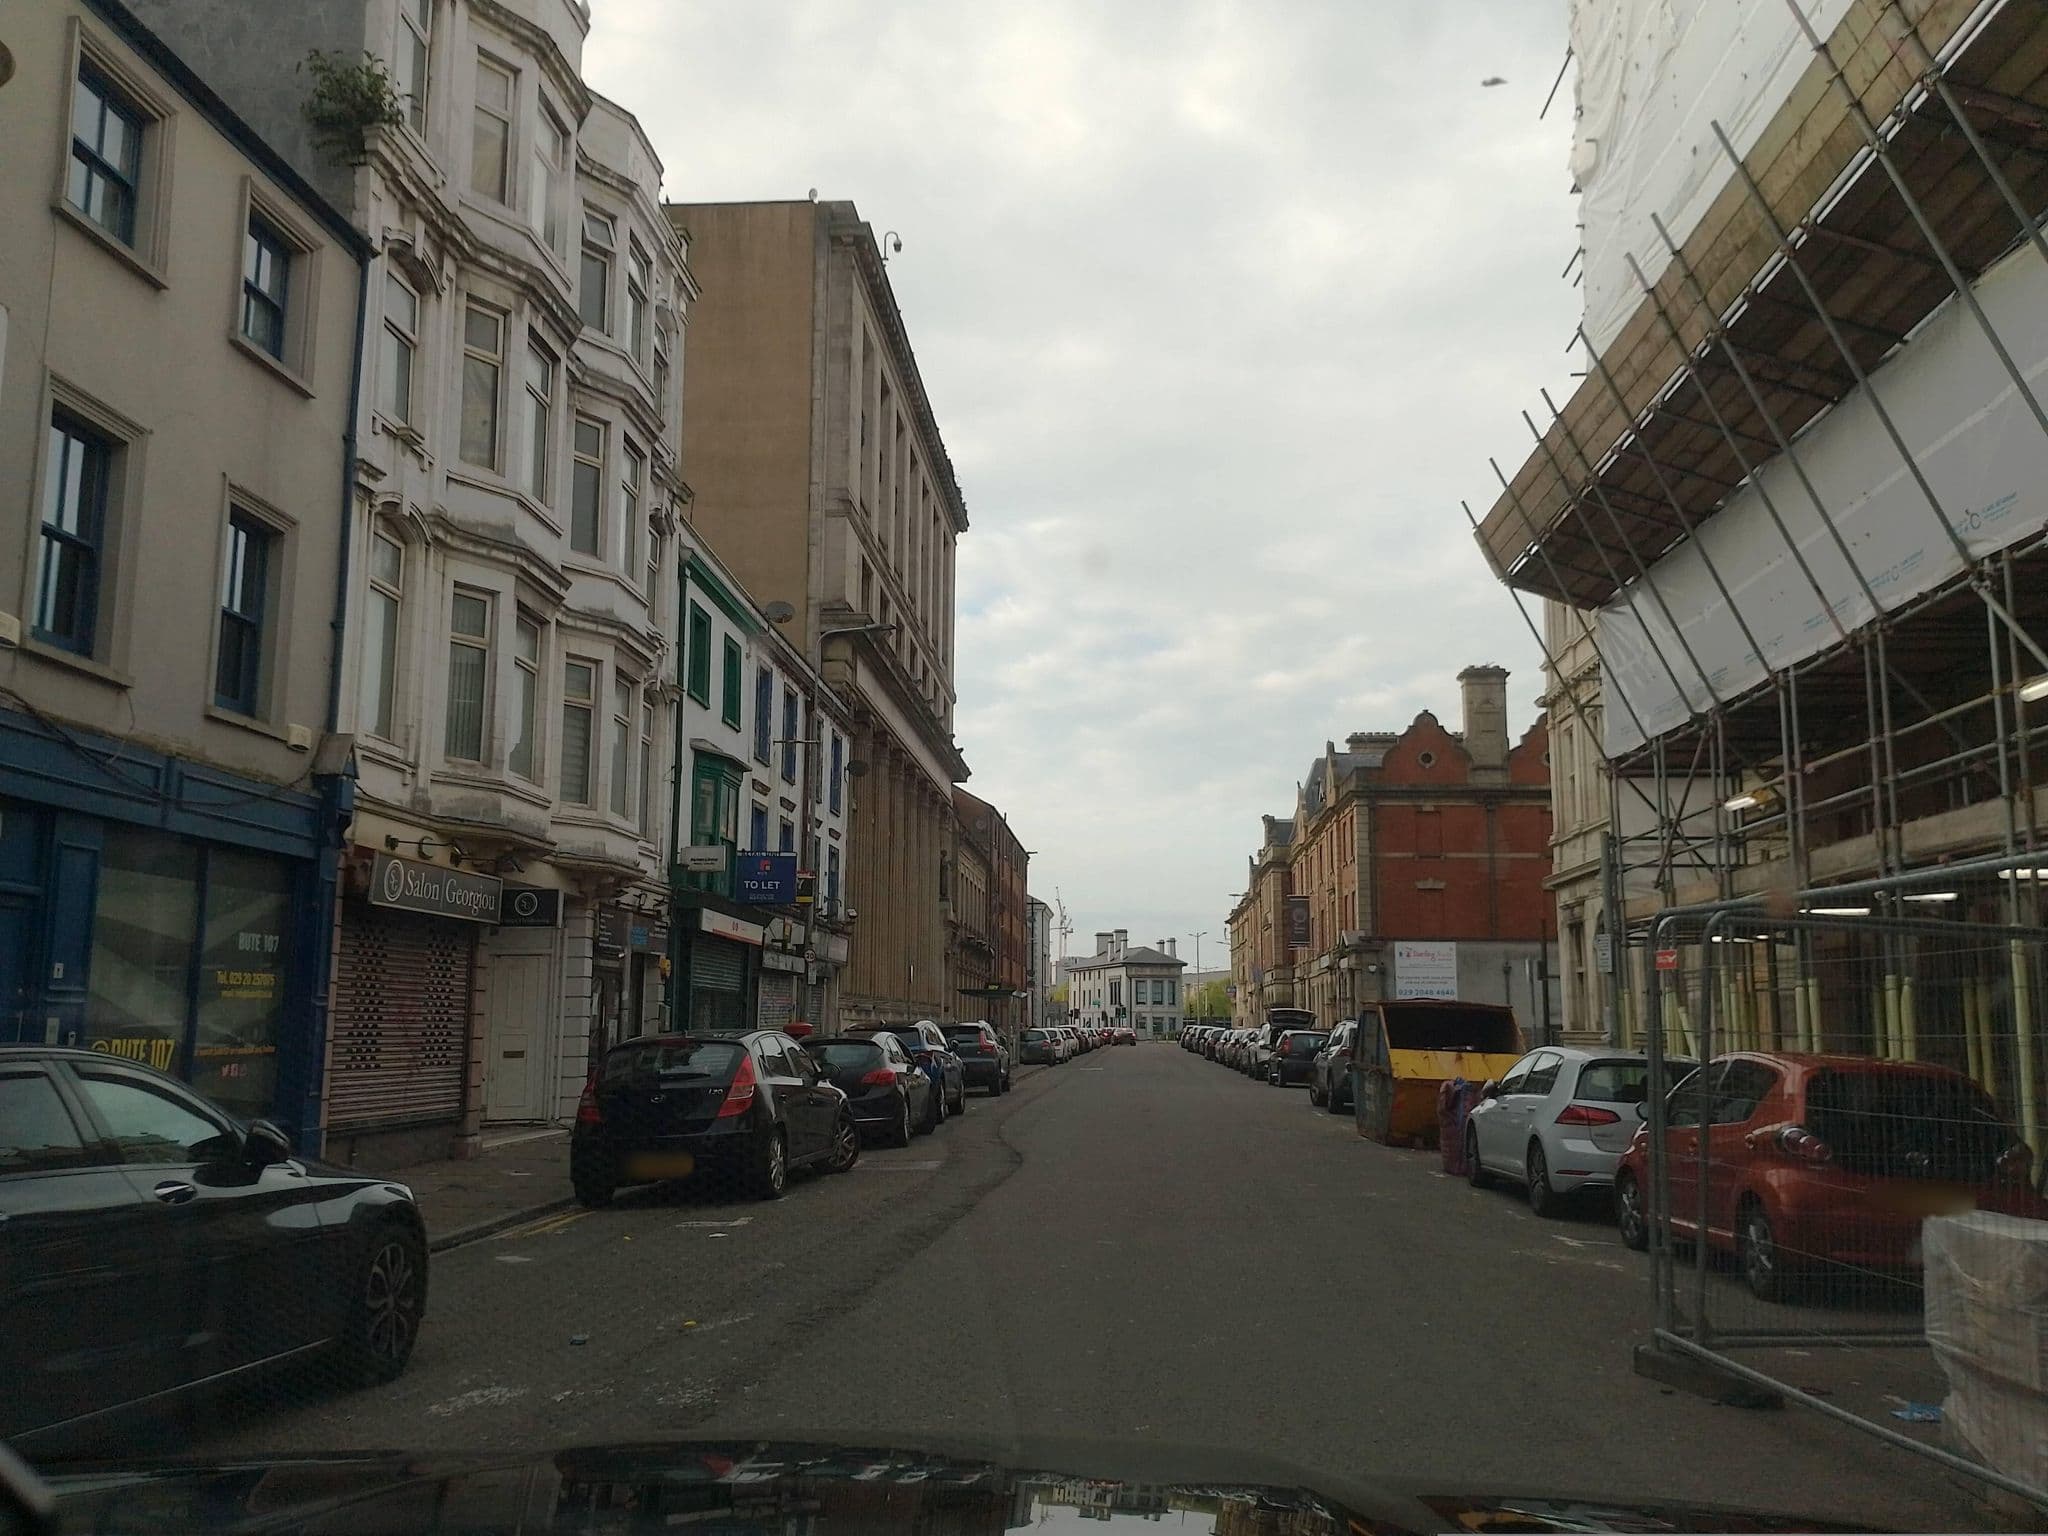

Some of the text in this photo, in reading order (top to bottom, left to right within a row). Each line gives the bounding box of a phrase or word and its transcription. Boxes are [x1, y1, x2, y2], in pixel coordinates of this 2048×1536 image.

[405, 869, 440, 901] Salon
[445, 878, 495, 916] Georgiou
[743, 880, 781, 890] TO LET
[238, 932, 280, 953] BUTE 107
[151, 1039, 176, 1071] 107
